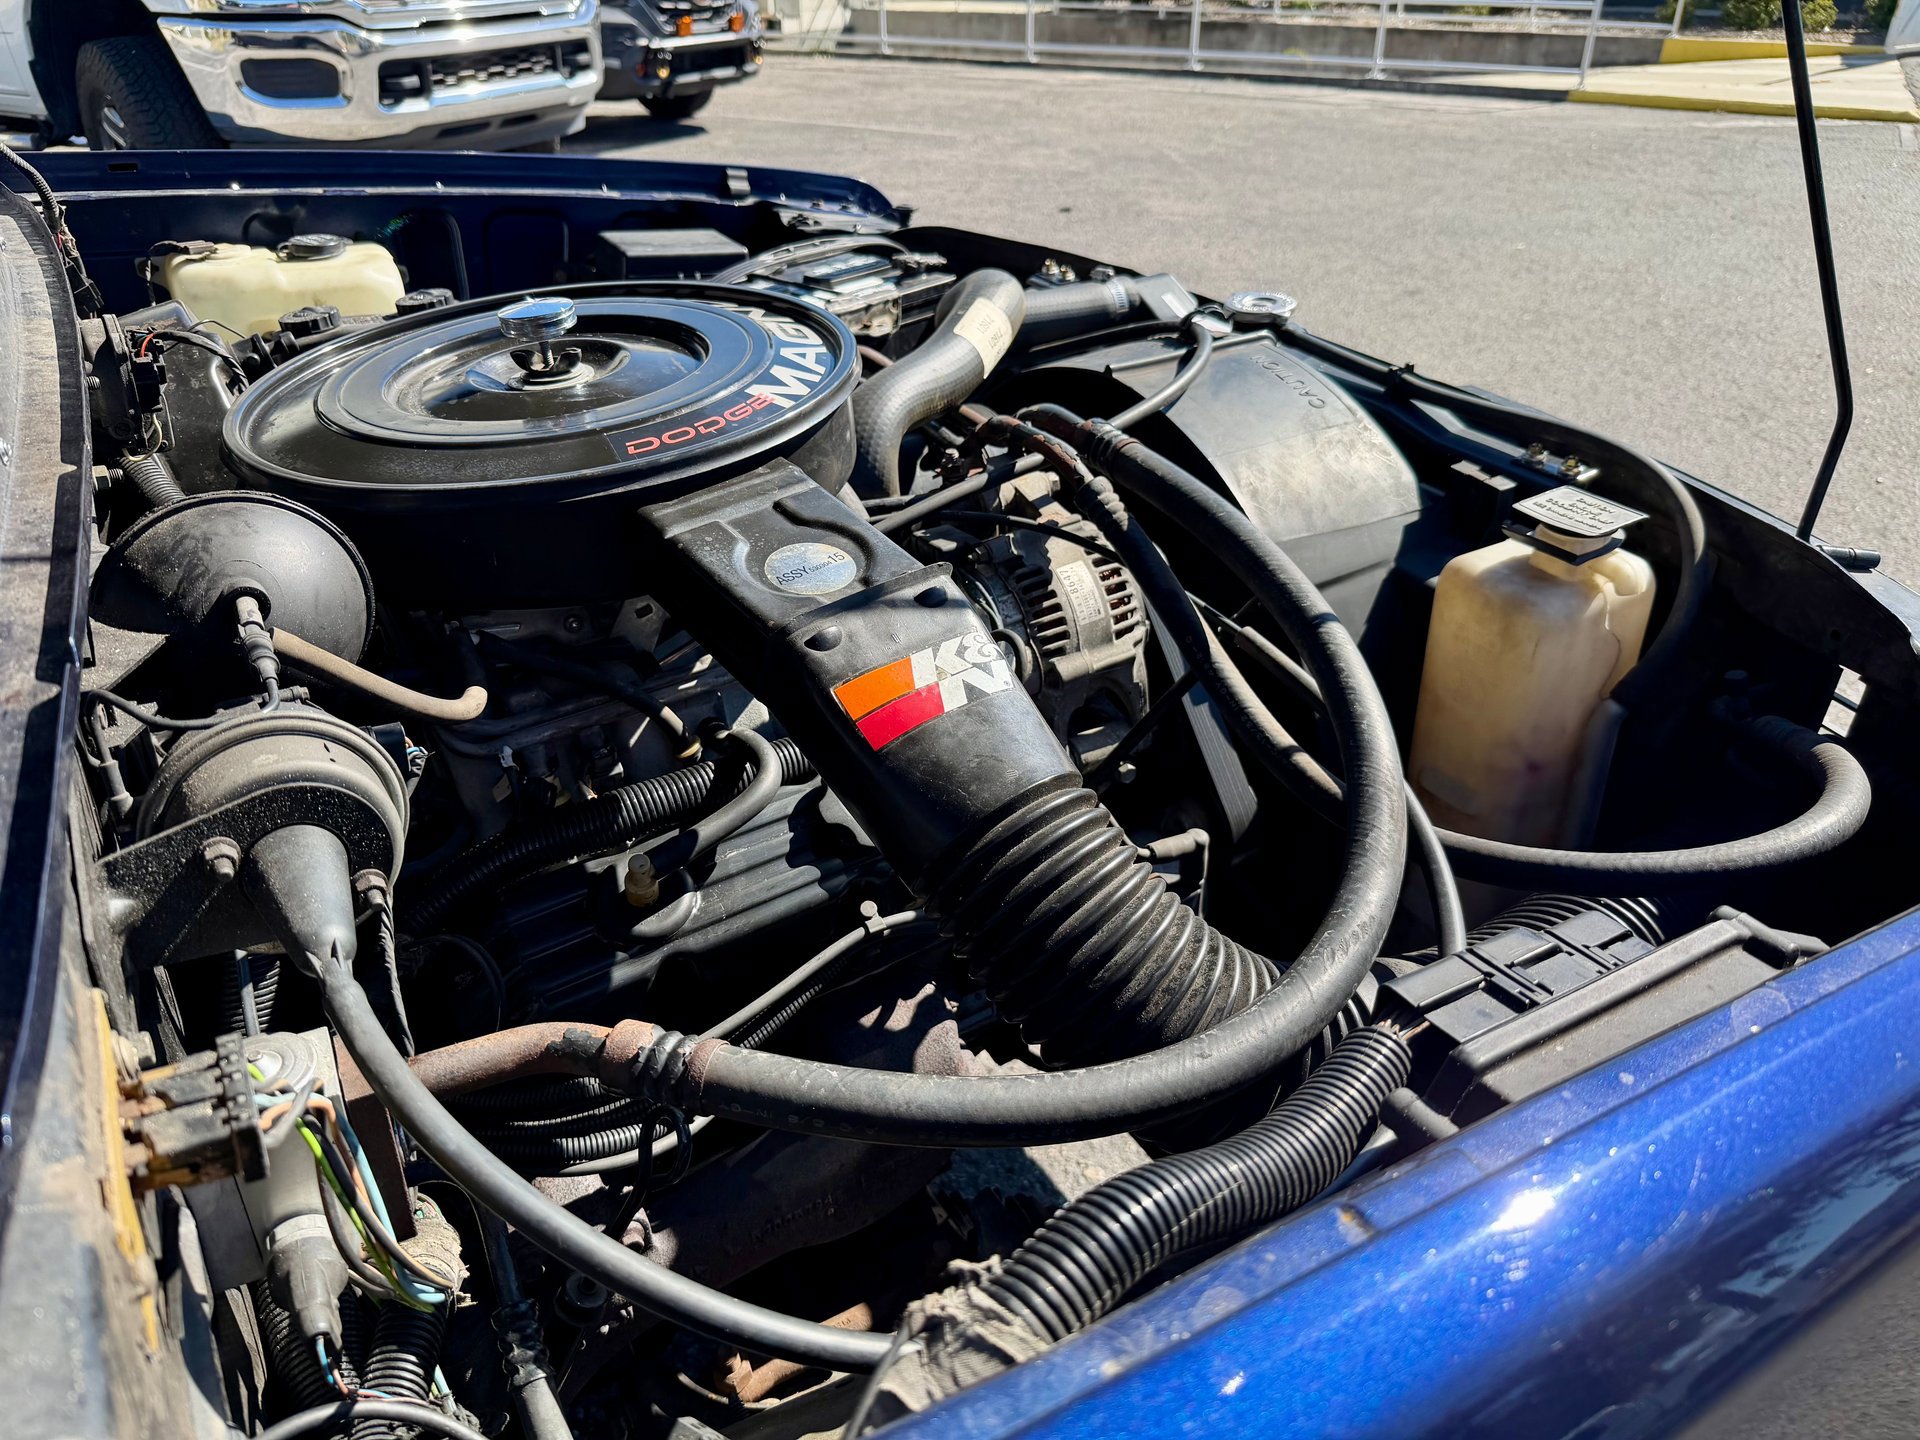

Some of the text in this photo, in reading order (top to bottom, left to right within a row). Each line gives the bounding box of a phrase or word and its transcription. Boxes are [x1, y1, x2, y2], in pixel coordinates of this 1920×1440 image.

[690, 299, 828, 410] MAGN
[1250, 355, 1327, 410] CAUTION
[625, 392, 778, 455] DODGE
[775, 565, 810, 586] ASSY
[911, 626, 1014, 714] K&N
